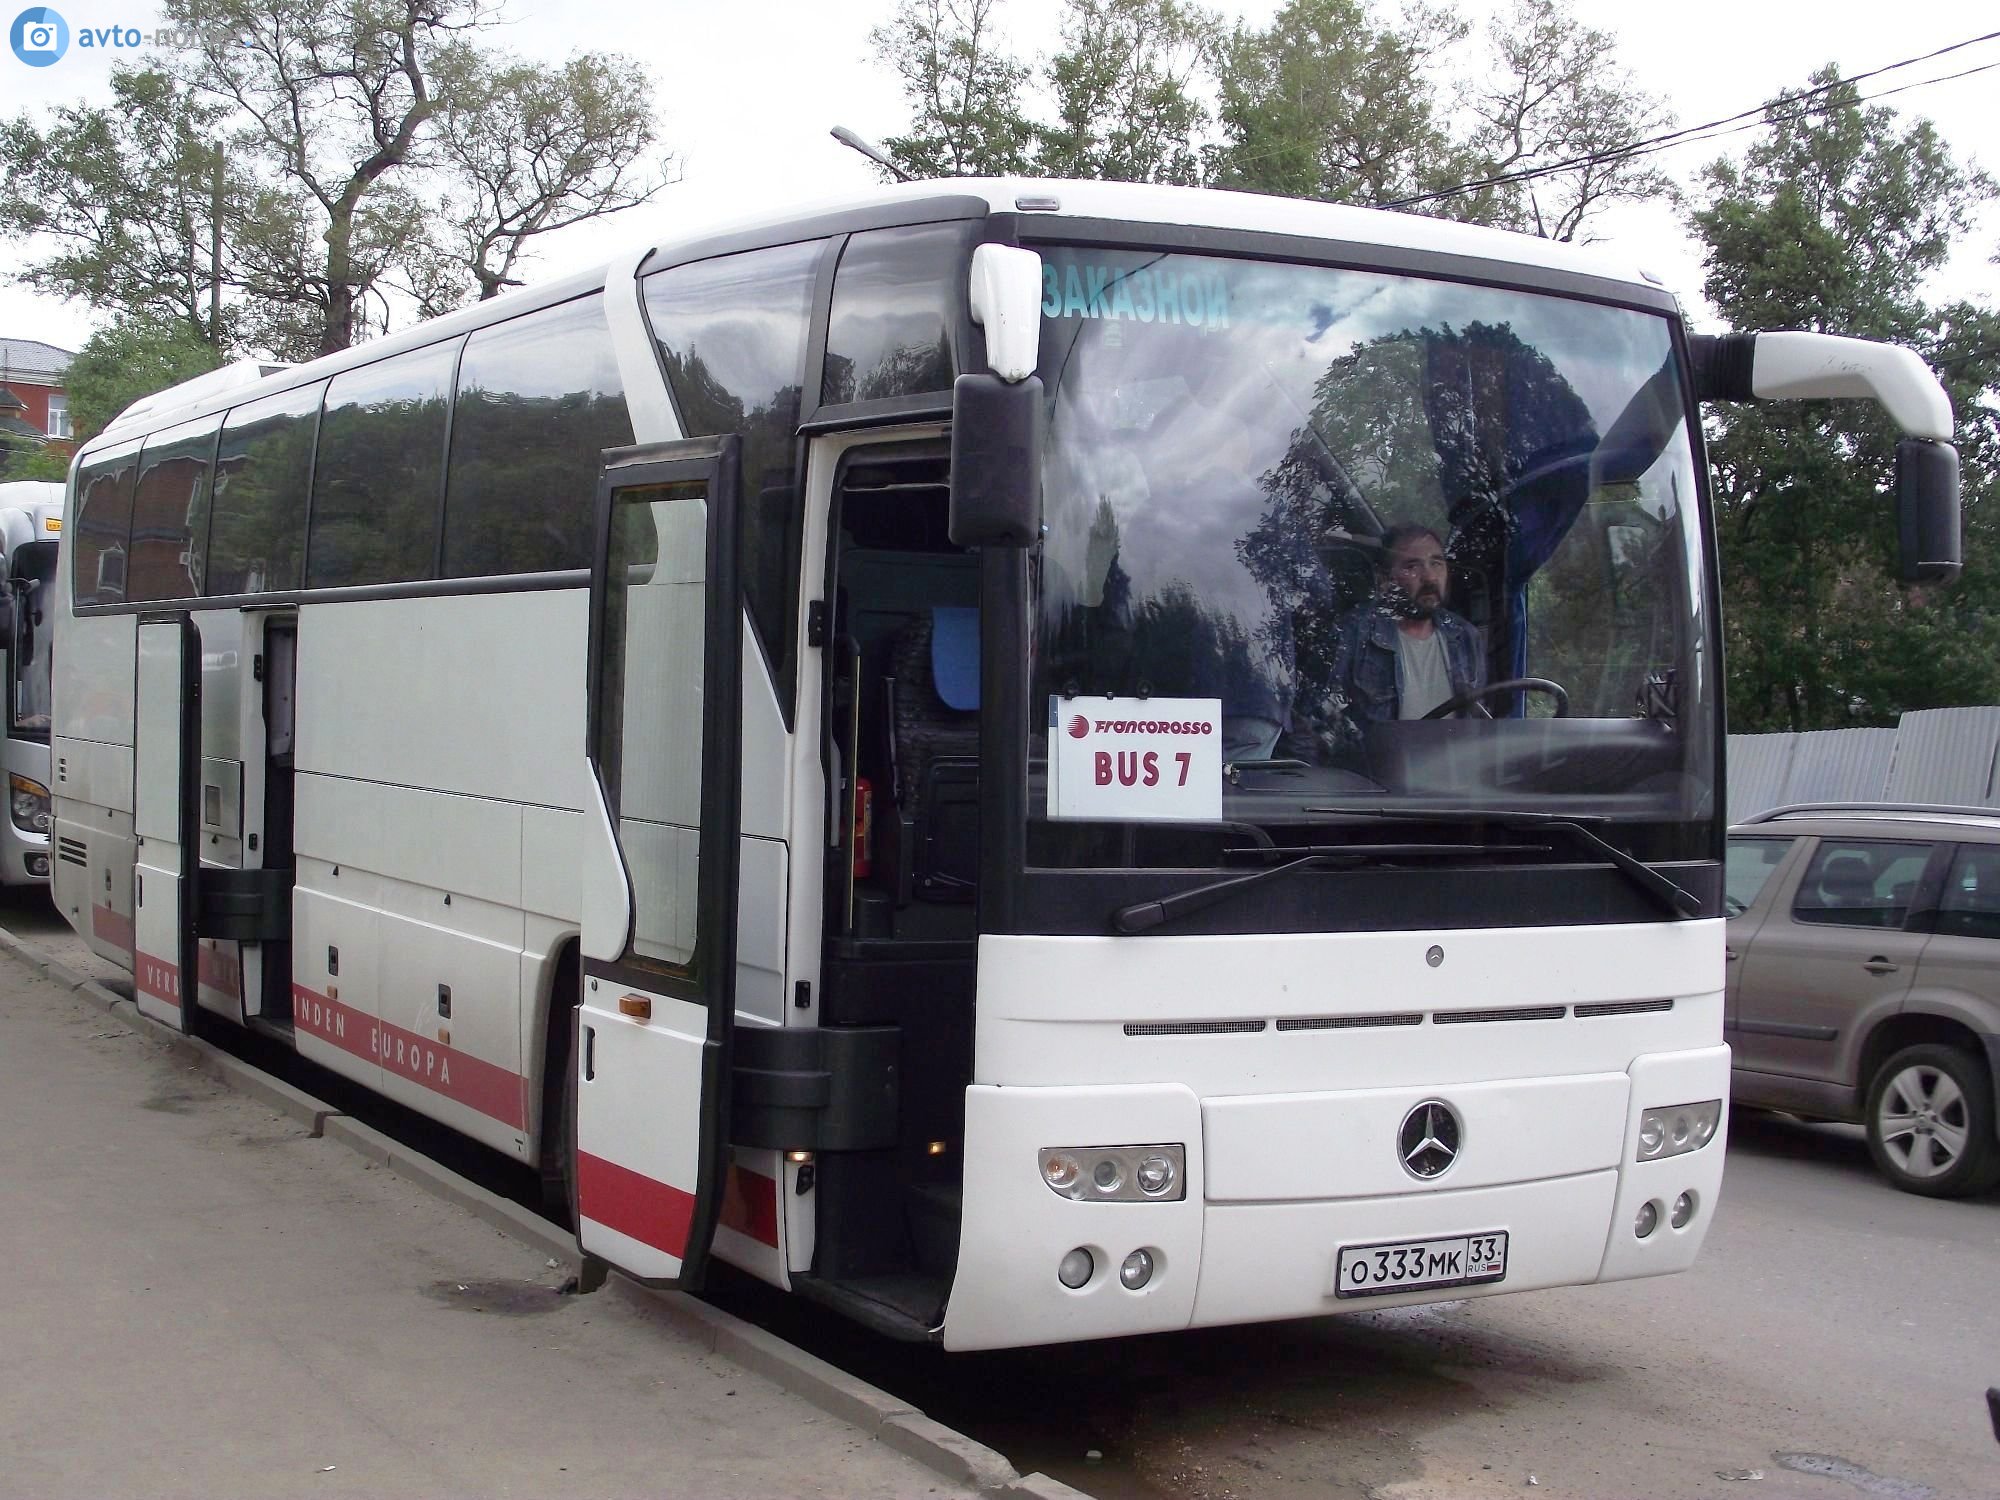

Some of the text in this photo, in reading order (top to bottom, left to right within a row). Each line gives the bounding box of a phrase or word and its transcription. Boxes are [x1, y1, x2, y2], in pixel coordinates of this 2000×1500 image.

[1095, 751, 1192, 787] BUS 7
[371, 1027, 450, 1085] EUROPA
[1471, 1238, 1497, 1263] 33
[1467, 1263, 1486, 1273] RUS
